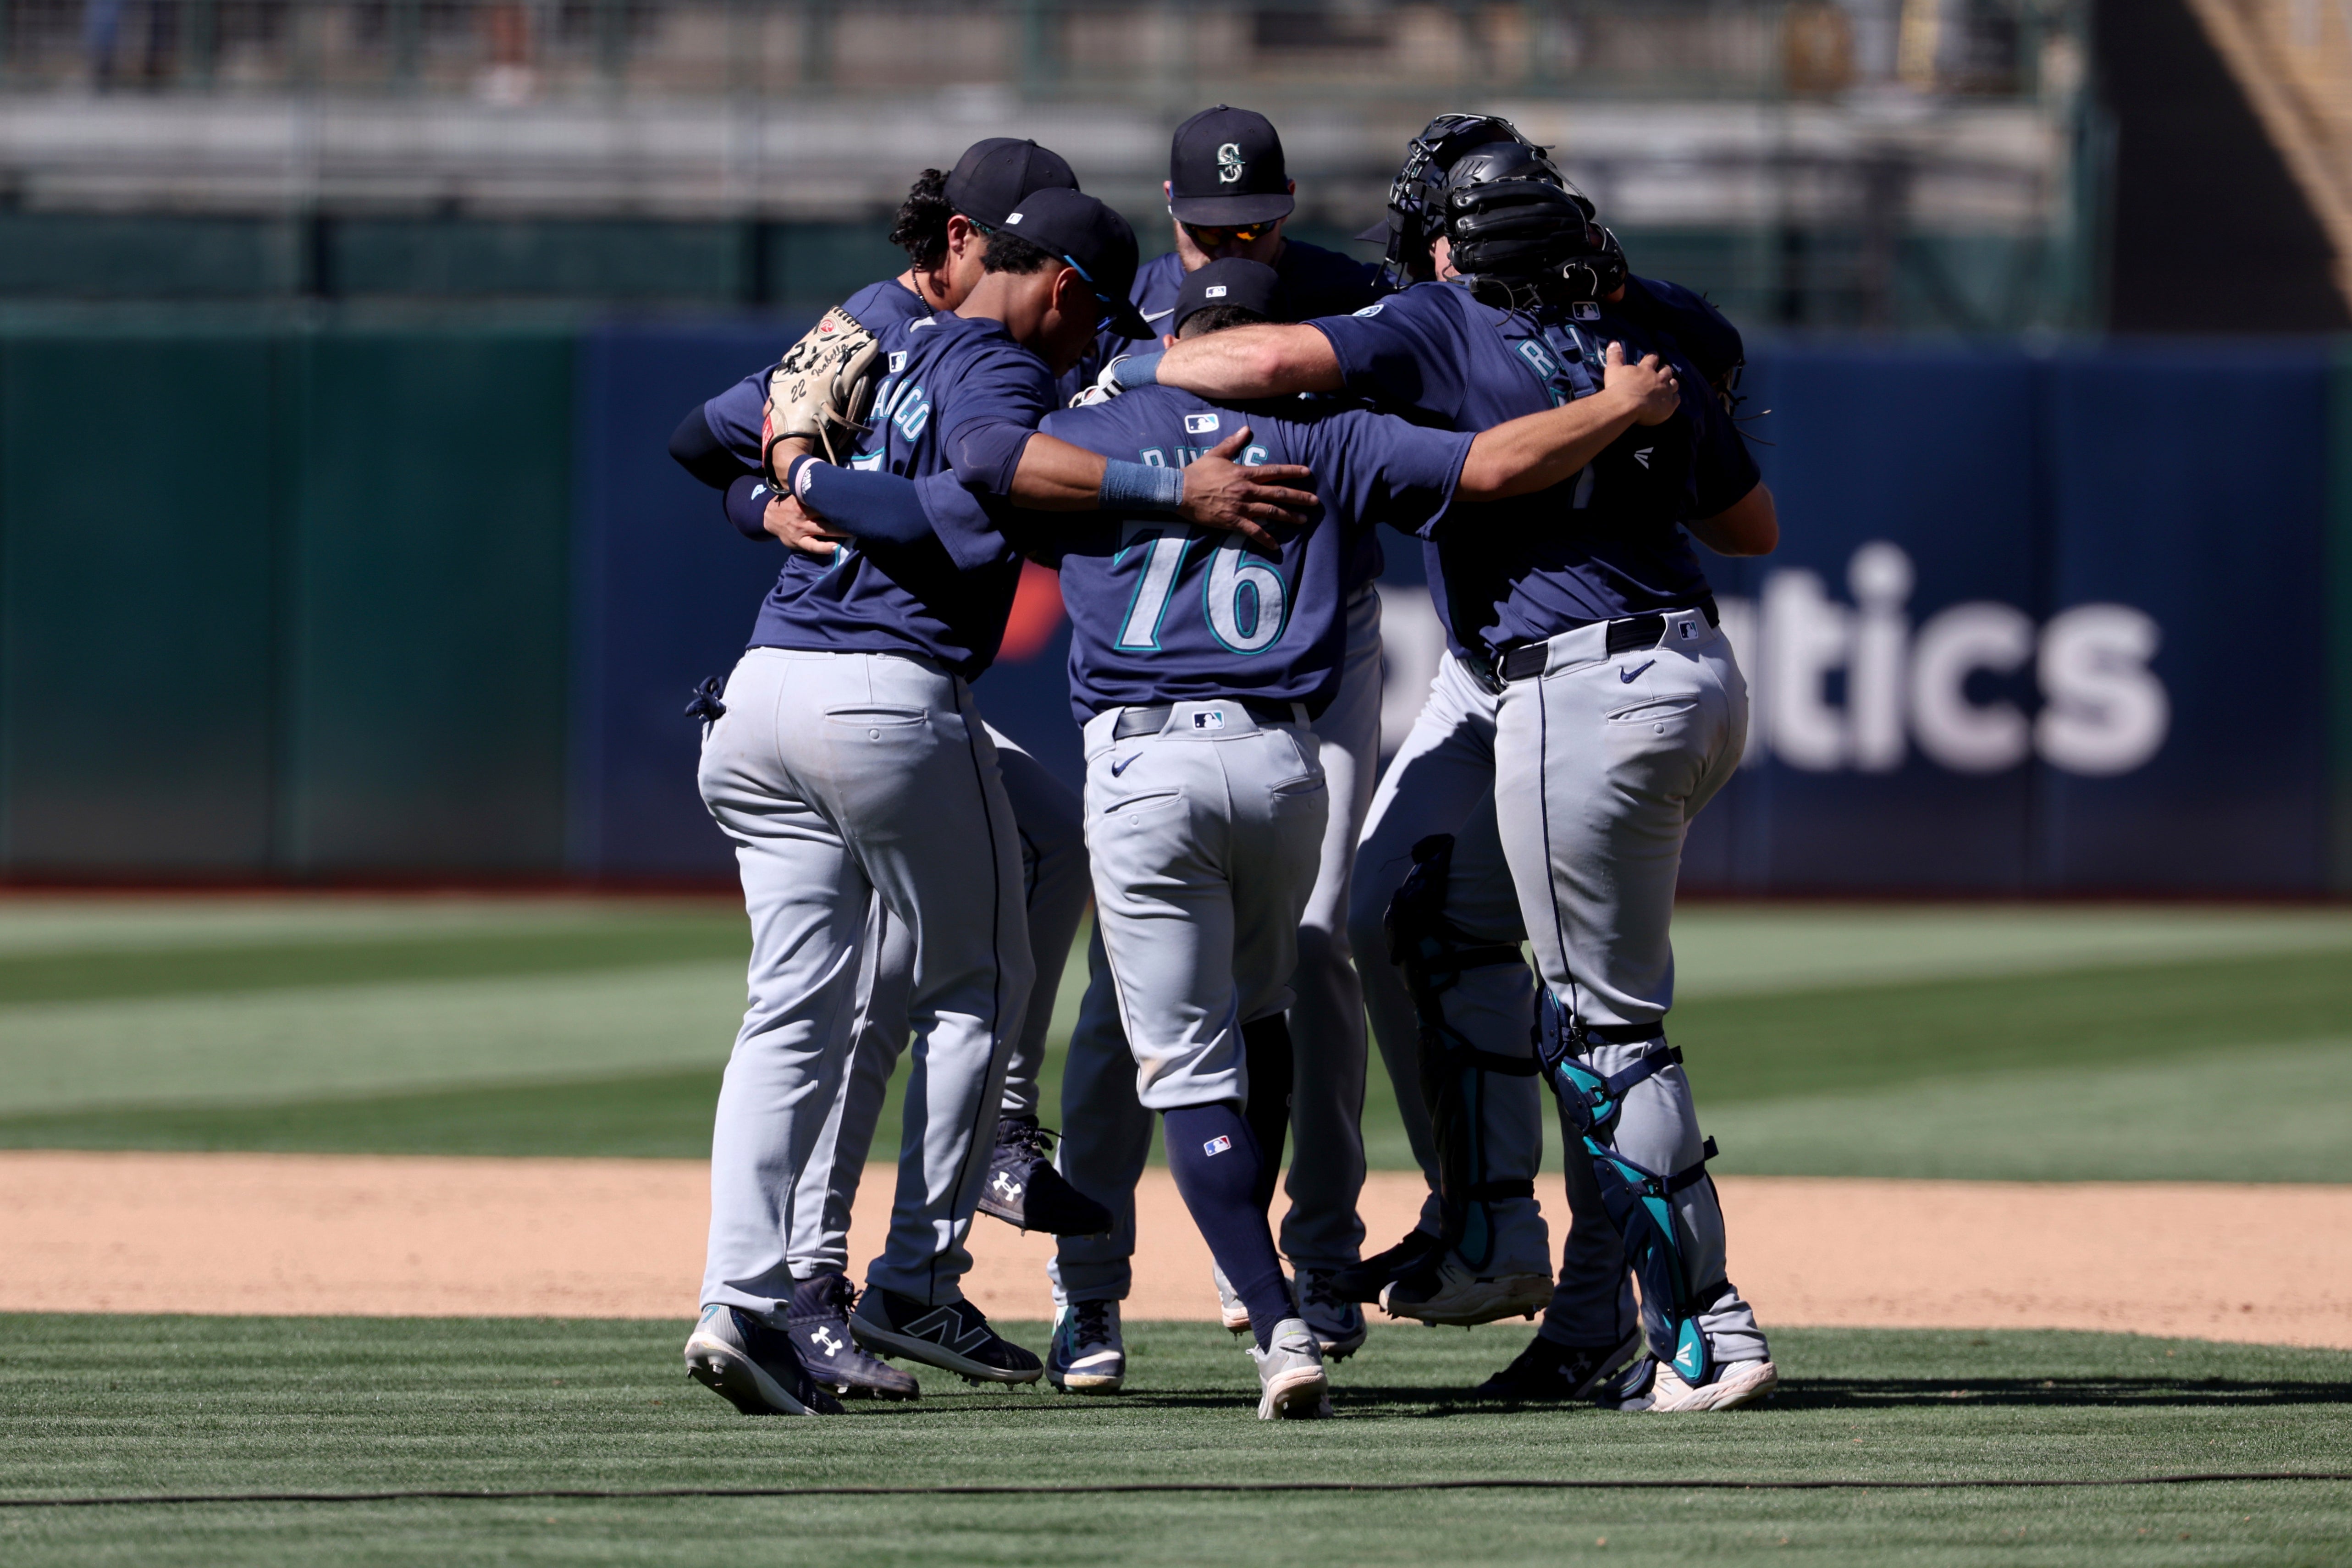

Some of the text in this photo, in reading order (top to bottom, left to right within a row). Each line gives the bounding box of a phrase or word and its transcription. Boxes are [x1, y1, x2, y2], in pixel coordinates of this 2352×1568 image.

[1217, 143, 1246, 185] S
[811, 343, 849, 376] Isabella
[791, 379, 806, 403] 22
[864, 377, 930, 442] ANCO
[1114, 519, 1287, 655] 76
[701, 1305, 720, 1324] 7
